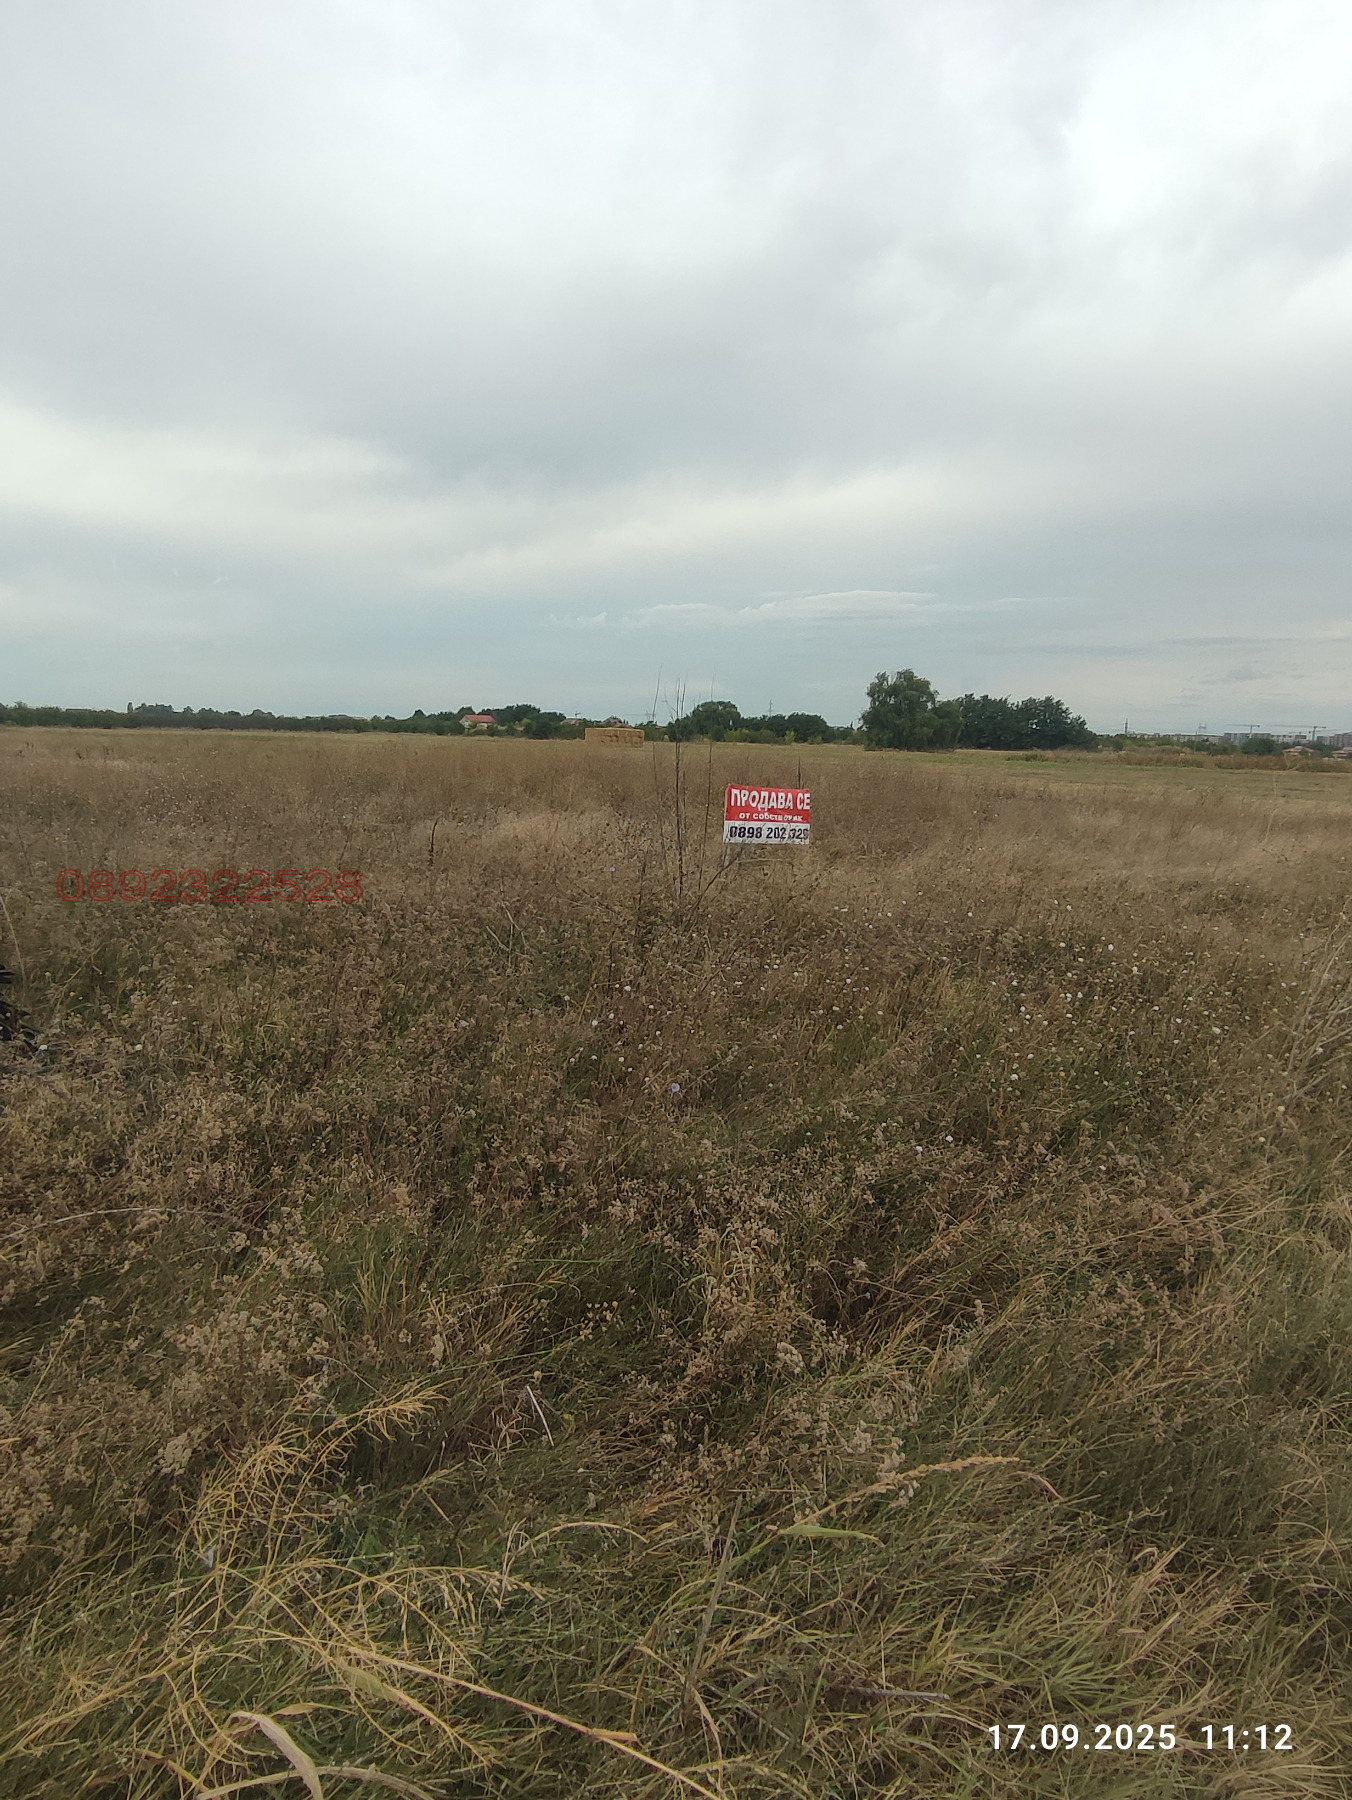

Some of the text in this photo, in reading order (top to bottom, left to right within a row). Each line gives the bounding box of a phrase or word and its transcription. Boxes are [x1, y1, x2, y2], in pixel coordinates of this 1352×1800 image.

[731, 789, 810, 811] ПРОДАВА СЕ
[730, 826, 762, 839] 0898
[766, 827, 786, 839] 202
